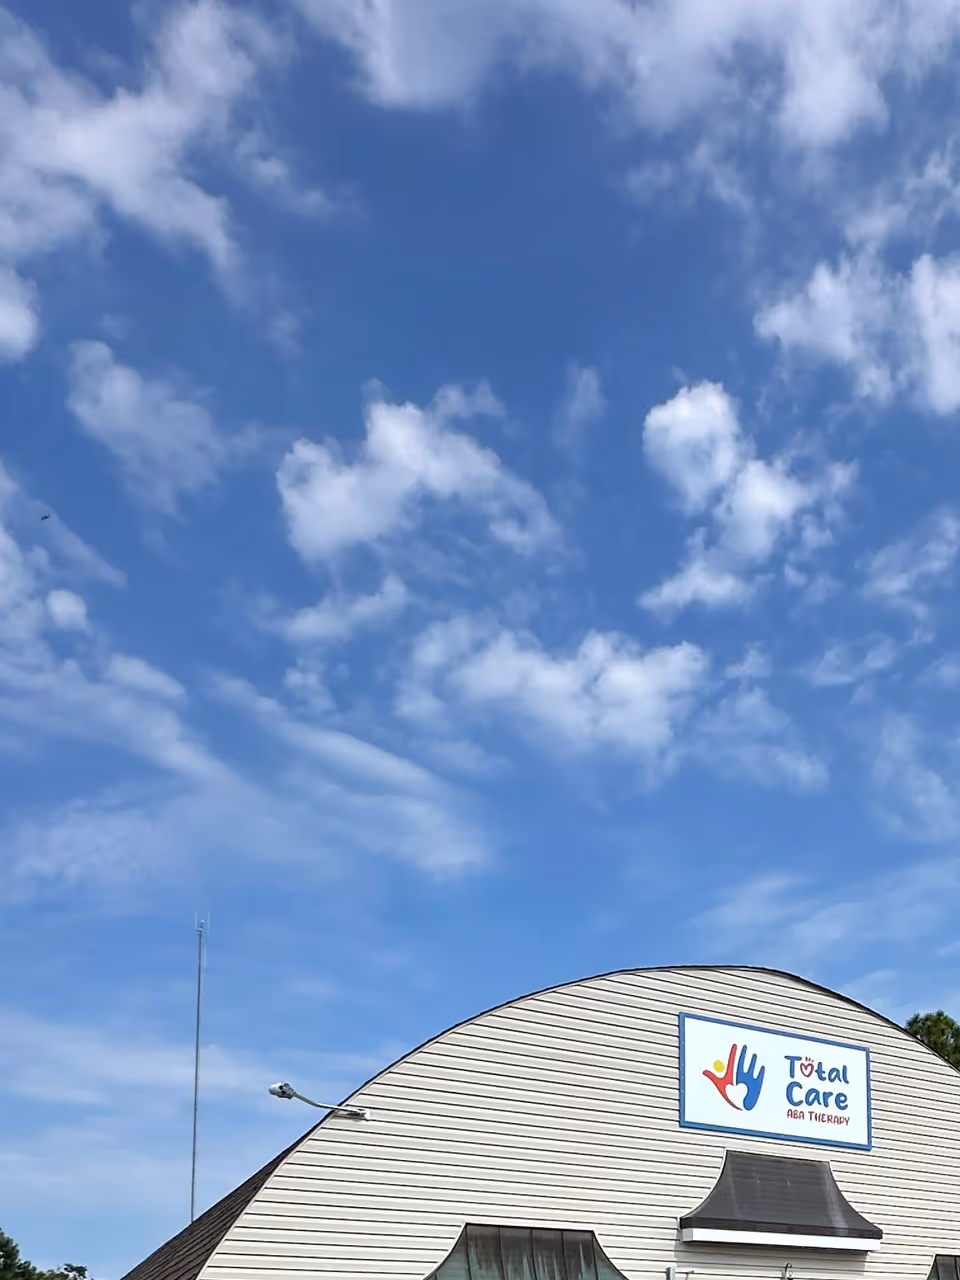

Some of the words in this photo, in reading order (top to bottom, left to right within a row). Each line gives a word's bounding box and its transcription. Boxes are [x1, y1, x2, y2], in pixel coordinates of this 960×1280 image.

[784, 1055, 850, 1085] Total
[786, 1081, 849, 1111] Care
[787, 1108, 805, 1121] ABA
[807, 1111, 850, 1127] THERAPY
